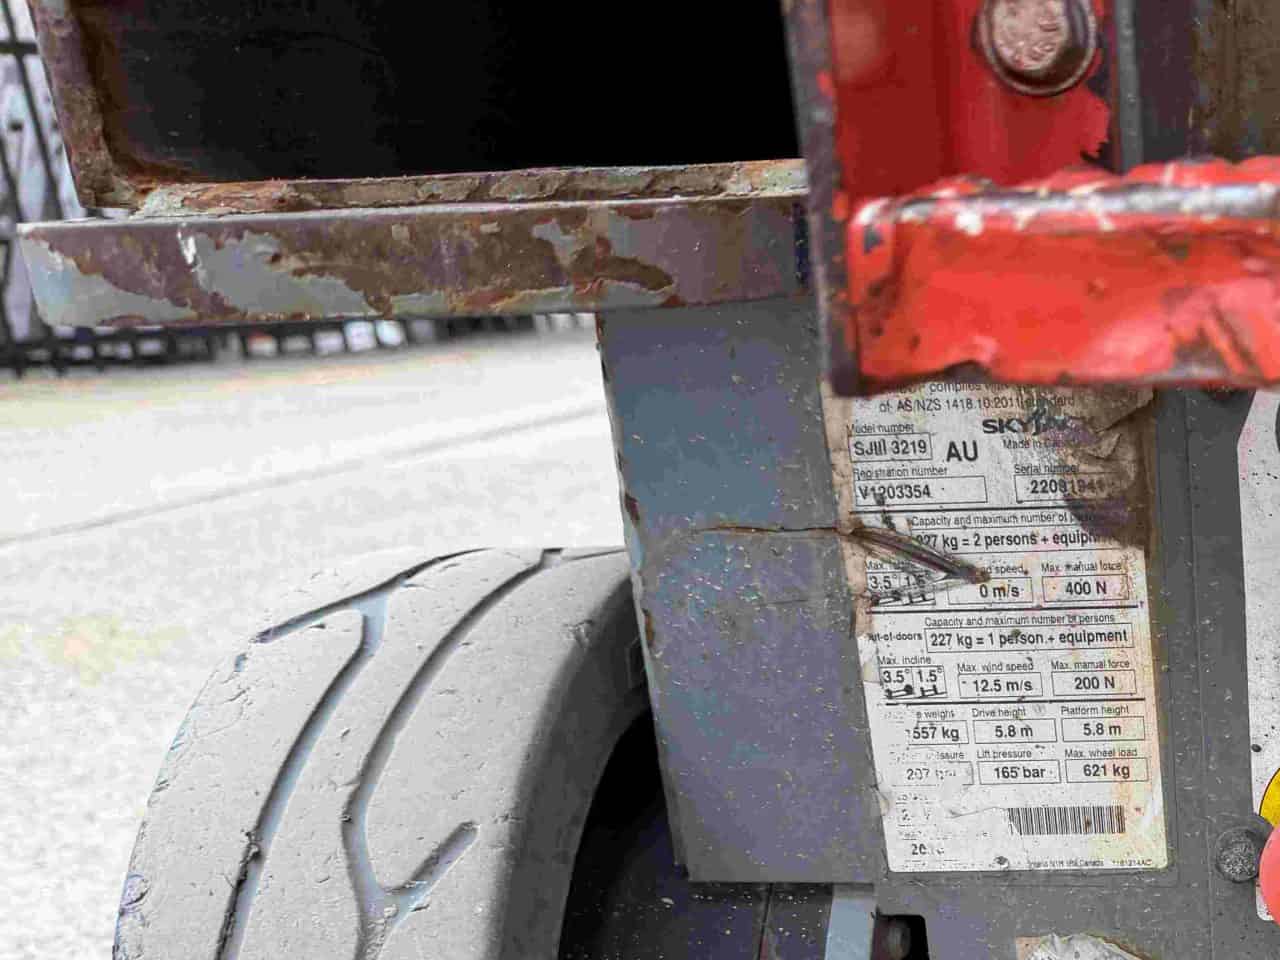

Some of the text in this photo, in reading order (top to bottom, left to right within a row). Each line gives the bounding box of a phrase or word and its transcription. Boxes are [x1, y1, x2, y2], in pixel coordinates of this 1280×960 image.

[877, 423, 914, 434] number
[891, 439, 927, 455] 3219
[947, 440, 978, 462] AU
[911, 466, 947, 476] number
[911, 516, 951, 527] Capacity
[954, 516, 972, 526] and
[973, 513, 1018, 525] maximum
[1020, 511, 1055, 523] number
[943, 533, 958, 550] kg
[973, 533, 981, 546] 2
[985, 533, 1037, 549] persons
[993, 582, 1020, 598] m/s
[1065, 580, 1107, 595] 400 N
[924, 617, 963, 627] Capacity
[967, 617, 983, 626] and
[985, 615, 1030, 626] maximum
[1079, 614, 1115, 624] persons
[930, 633, 952, 647] 227
[956, 633, 973, 649] kg
[1000, 631, 1044, 648] person
[1058, 629, 1128, 647] equipment
[902, 655, 931, 665] incline
[1006, 661, 1034, 672] speed
[1074, 660, 1105, 669] manual
[1108, 659, 1130, 669] force
[973, 679, 1033, 692] 12.5 m/s
[1074, 676, 1115, 690] 200 N
[971, 708, 995, 718] Drive
[1061, 704, 1129, 716] Platform height
[941, 726, 959, 741] kg
[995, 725, 1033, 738] 5.8 m
[1083, 723, 1121, 736] 5.8 m
[993, 750, 1032, 759] pressure
[1089, 748, 1115, 757] wheel
[1118, 747, 1138, 757] load
[994, 766, 1045, 779] 165 bar
[1083, 764, 1130, 779] 621 kg
